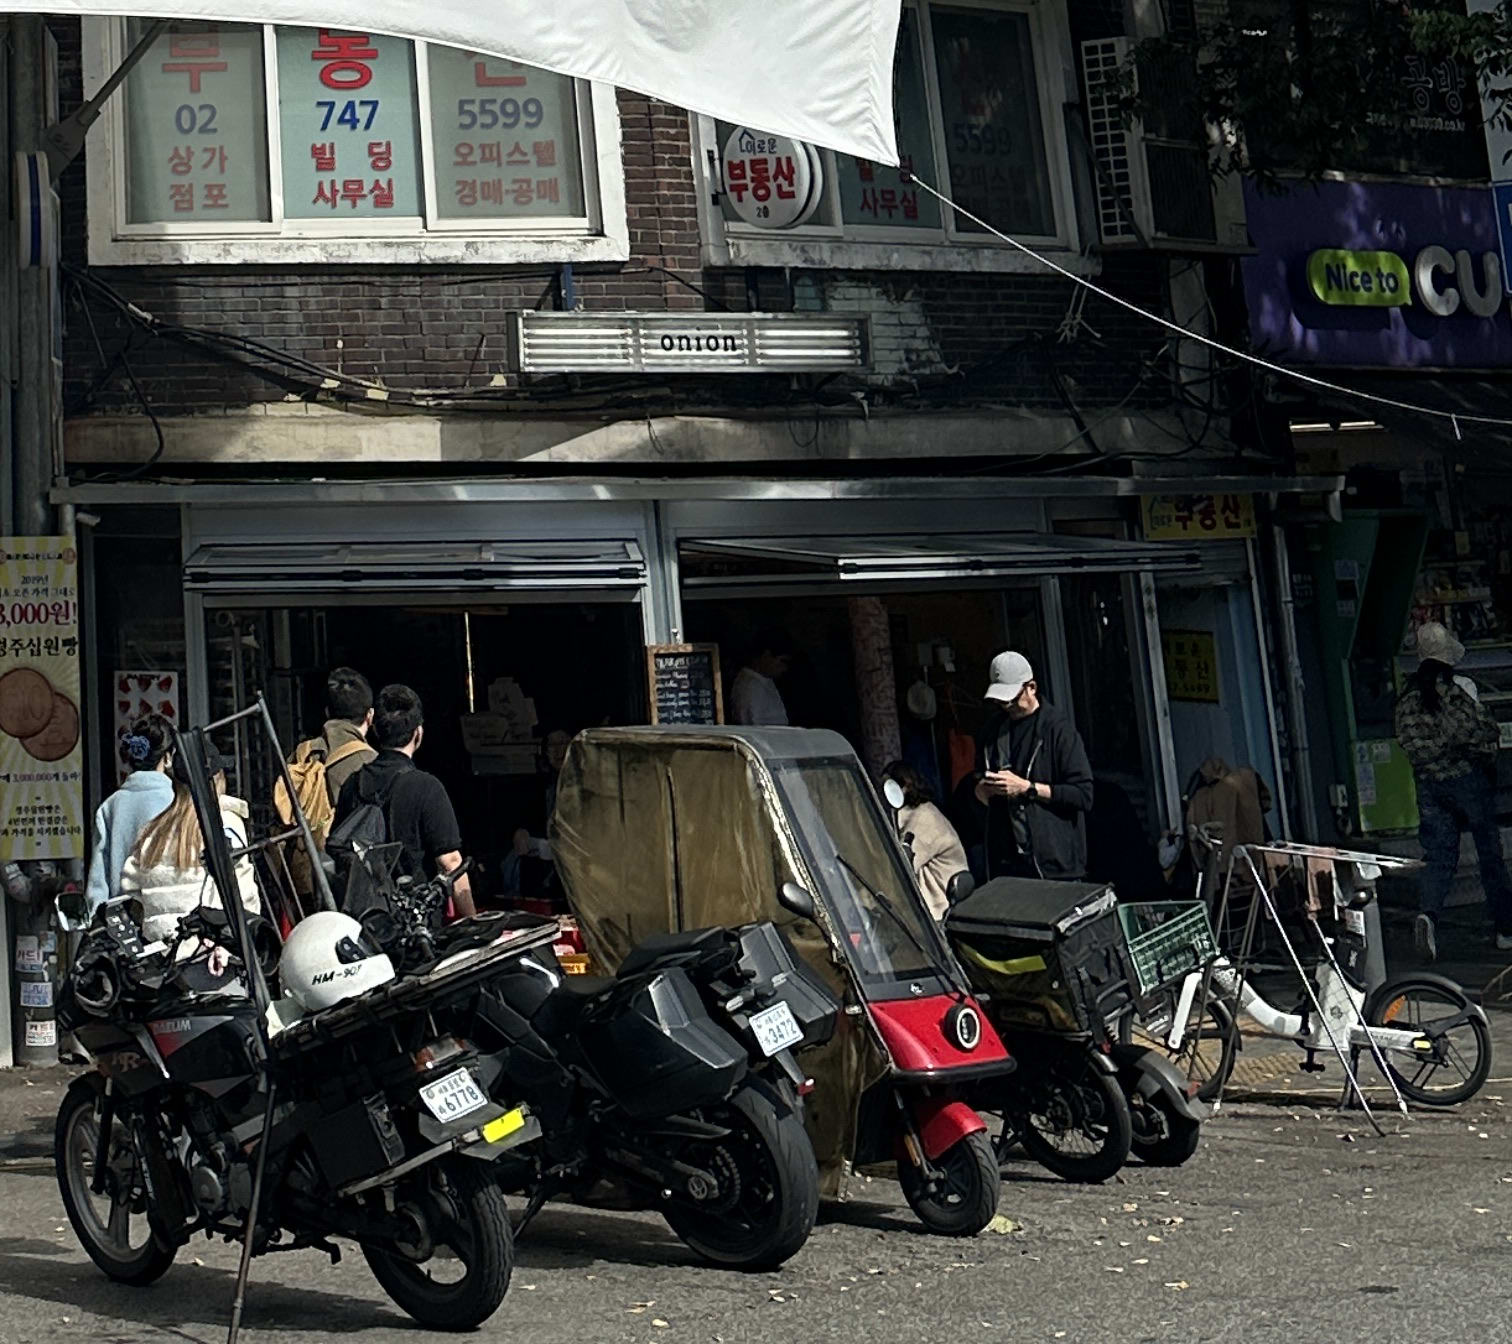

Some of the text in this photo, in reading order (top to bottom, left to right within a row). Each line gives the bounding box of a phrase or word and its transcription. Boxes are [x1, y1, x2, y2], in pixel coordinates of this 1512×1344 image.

[175, 98, 544, 135] 02 747 5599
[168, 144, 229, 174] 상가
[454, 140, 557, 169] 오피스텔
[168, 183, 229, 212] 점포
[312, 179, 395, 209] 사무실
[728, 157, 796, 202] 부동산
[860, 188, 918, 220] 사무실
[1324, 263, 1399, 294] Nice to
[1414, 244, 1502, 317] CU
[661, 326, 737, 351] onion
[444, 1085, 478, 1112] 6778
